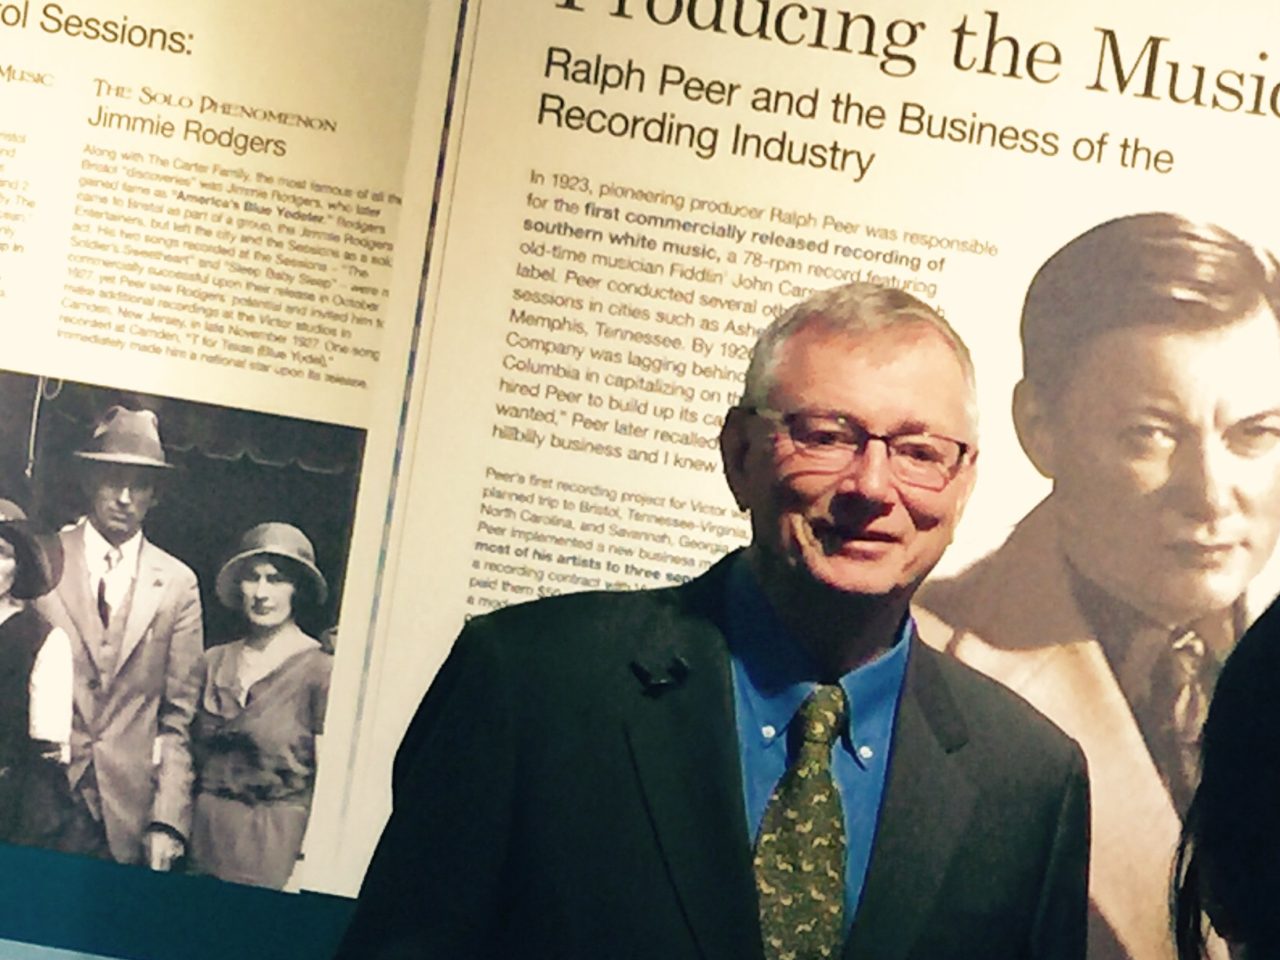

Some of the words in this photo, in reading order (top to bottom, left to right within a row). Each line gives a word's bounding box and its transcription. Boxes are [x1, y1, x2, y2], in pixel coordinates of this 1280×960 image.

[39, 2, 193, 55] Sessions:
[554, 0, 924, 77] oducing
[949, 9, 1062, 84] the
[86, 104, 175, 138] Jimmie
[182, 118, 287, 157] Rodgers
[138, 85, 194, 109] SOLO
[198, 94, 337, 133] PHENOMENON
[543, 45, 645, 95] Ralph
[658, 63, 741, 107] Peer
[749, 86, 819, 119] and
[830, 92, 886, 130] the
[898, 101, 1059, 156] Business
[1071, 131, 1110, 163] of
[1118, 136, 1174, 174] the
[537, 92, 719, 160] Recording
[731, 122, 876, 183] Industry
[525, 191, 550, 209] for
[553, 196, 580, 215] the
[583, 200, 620, 222] first
[624, 210, 747, 244] commercially
[749, 230, 829, 255] released
[833, 243, 921, 272] recording
[925, 256, 946, 272] of
[529, 168, 545, 186] In
[551, 172, 593, 196] 1923,
[597, 181, 685, 212] pioneering
[688, 197, 766, 220] producer
[768, 206, 817, 229] Ralph
[821, 214, 861, 234] Peer
[864, 224, 898, 241] was
[902, 230, 998, 257] responsible
[518, 239, 587, 263] old-time
[590, 252, 664, 276] musician
[730, 272, 773, 293] John
[522, 218, 603, 242] southern
[608, 231, 657, 251] white
[661, 240, 721, 264] music,
[725, 250, 737, 264] a
[742, 249, 803, 274] 78-rpm
[808, 263, 861, 284] record
[511, 287, 584, 311] sessions
[587, 296, 603, 313] in
[606, 301, 651, 321] cities
[654, 310, 695, 328] such
[698, 317, 719, 332] as
[563, 268, 603, 288] Peer
[606, 279, 695, 305] conducted
[698, 293, 758, 314] several
[504, 330, 586, 361] Company
[588, 346, 622, 364] was
[626, 349, 687, 378] lagging
[508, 307, 589, 337] Memphis,
[690, 335, 714, 358] By
[498, 376, 541, 398] hired
[544, 383, 583, 404] Peer
[586, 391, 604, 408] to
[607, 394, 649, 415] build
[651, 404, 675, 422] up
[678, 405, 698, 423] its
[501, 353, 580, 381] Columbia
[584, 366, 600, 384] in
[603, 372, 695, 403] capitalizing
[698, 388, 721, 403] on
[491, 423, 546, 448] hillbilly
[549, 431, 622, 458] business
[626, 447, 659, 464] and
[663, 450, 669, 465] I
[672, 452, 717, 473] knew
[570, 411, 610, 432] Peer
[613, 418, 650, 438] later
[473, 540, 511, 555] most
[513, 546, 530, 558] of
[531, 547, 553, 563] his
[555, 553, 602, 570] artists
[605, 559, 621, 573] to
[624, 563, 661, 580] three
